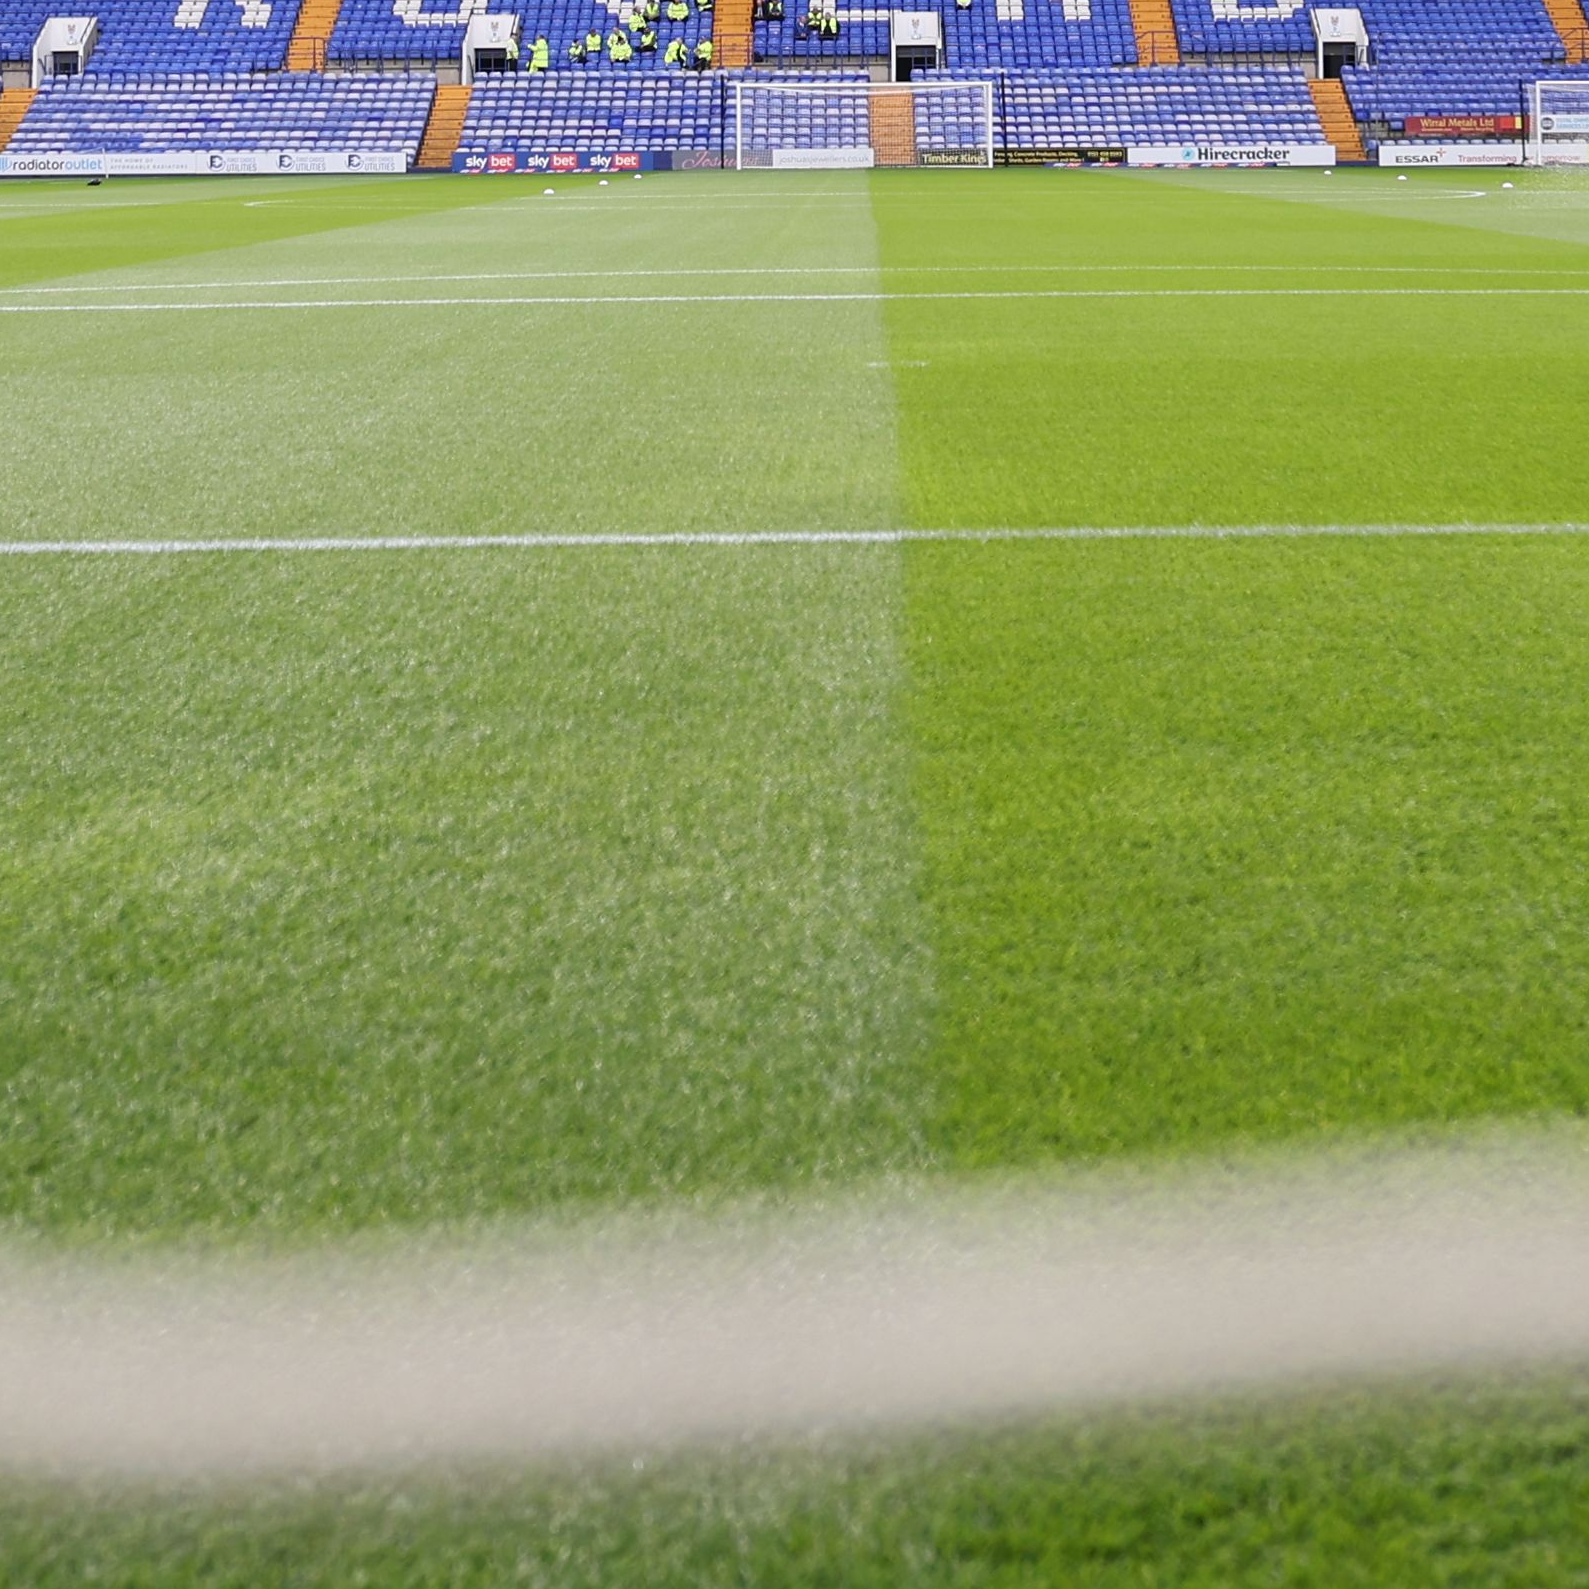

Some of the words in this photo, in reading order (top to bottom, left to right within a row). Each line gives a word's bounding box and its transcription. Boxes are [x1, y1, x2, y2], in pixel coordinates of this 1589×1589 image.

[1420, 118, 1445, 128] Wirral
[1448, 118, 1477, 128] Metals
[1480, 118, 1494, 128] Ltd
[922, 153, 959, 164] Timber
[961, 152, 987, 166] Kings
[1198, 148, 1289, 160] Hirecracker
[1395, 155, 1439, 164] ESSAR
[1458, 155, 1517, 165] Transforming
[13, 156, 102, 170] radiatoroutlet
[466, 154, 487, 169] sky
[491, 155, 512, 166] bet
[528, 154, 549, 169] sky
[553, 155, 574, 166] bet
[590, 154, 612, 169] sky
[616, 155, 636, 166] bet
